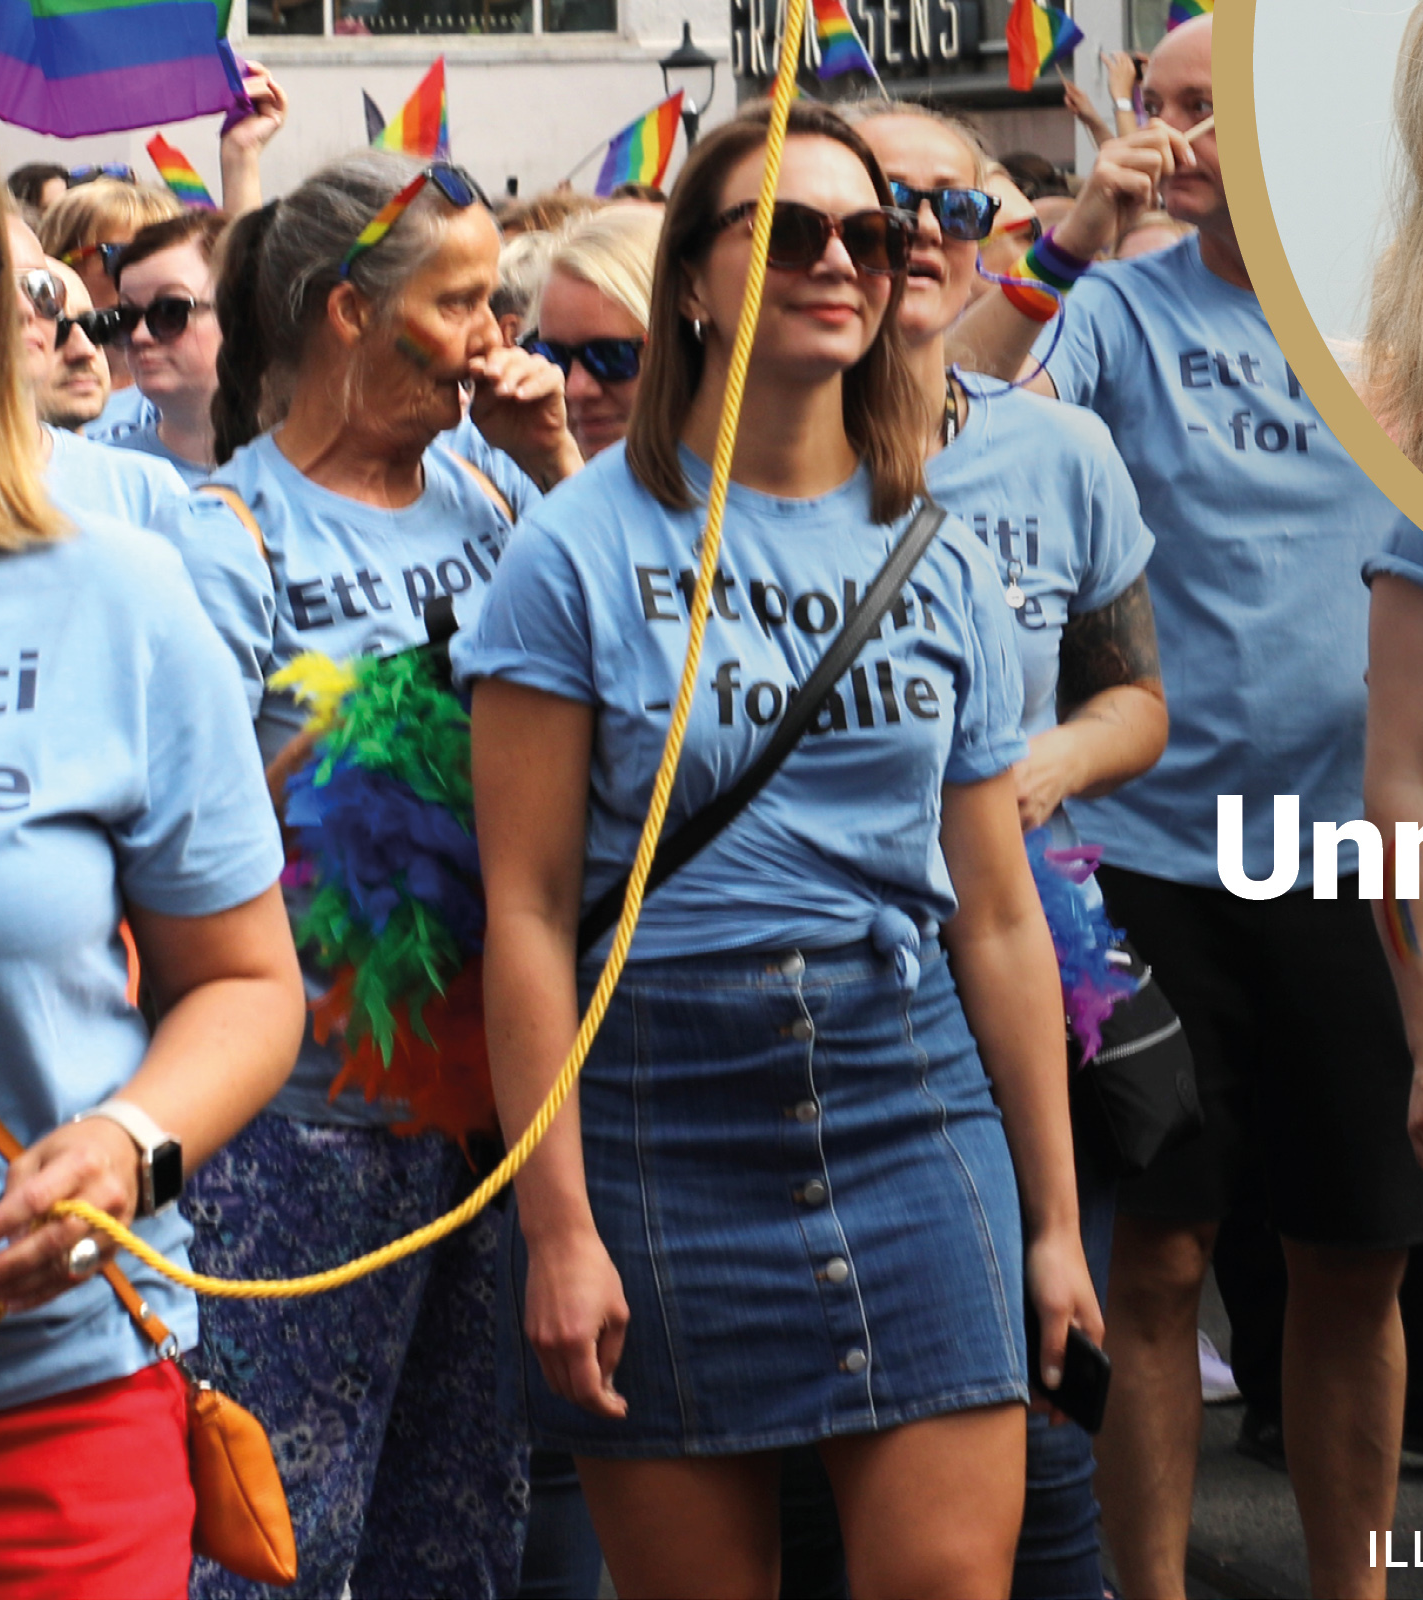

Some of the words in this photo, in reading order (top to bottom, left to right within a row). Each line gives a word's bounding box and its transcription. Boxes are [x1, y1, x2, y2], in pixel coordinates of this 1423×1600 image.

[1179, 349, 1263, 388] Ett
[1228, 411, 1318, 454] for
[286, 567, 392, 632] Ett
[402, 526, 506, 619] poli
